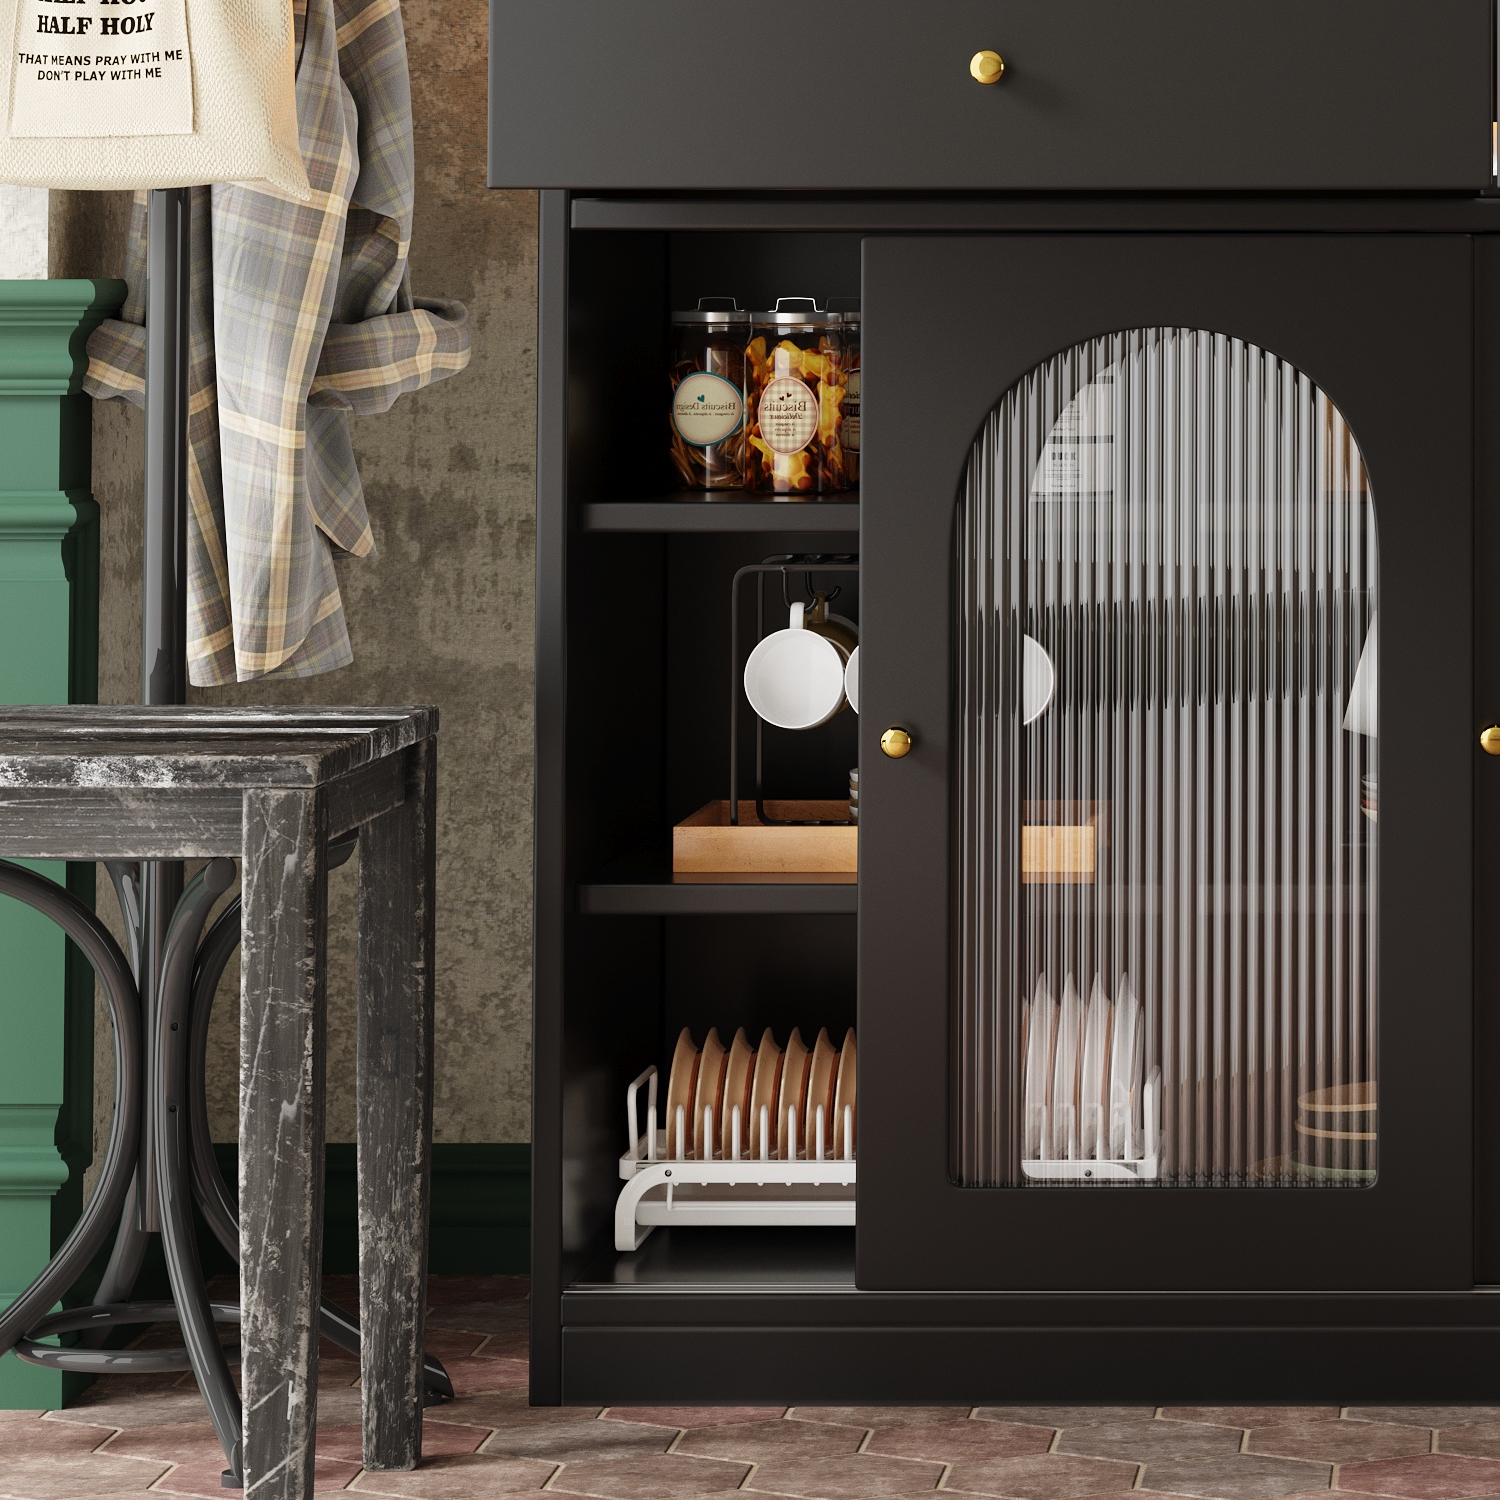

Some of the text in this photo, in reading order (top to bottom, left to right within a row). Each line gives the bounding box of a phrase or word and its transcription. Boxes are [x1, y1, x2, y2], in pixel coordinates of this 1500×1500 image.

[37, 12, 155, 35] HALF HOLY
[18, 49, 183, 66] THAT MEANS PRAY WITH ME
[37, 67, 162, 81] DON'T PLAY WITH ME
[1051, 452, 1077, 461] DUCK
